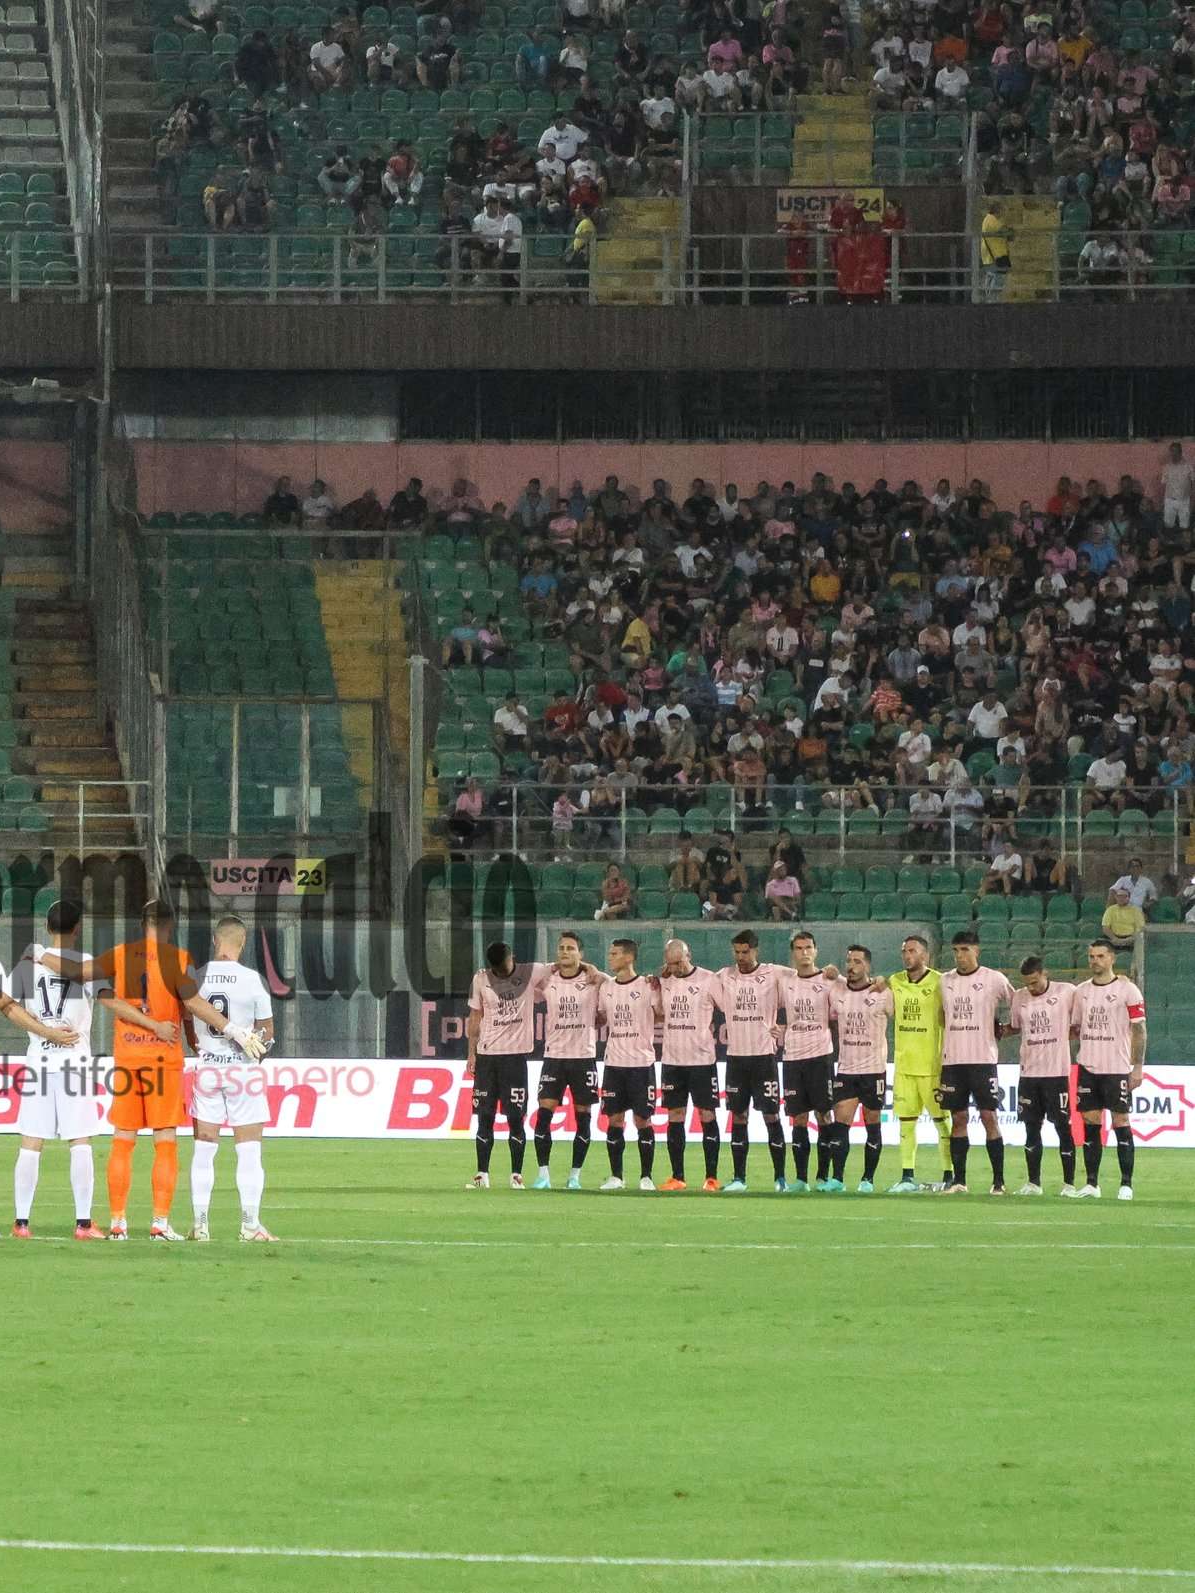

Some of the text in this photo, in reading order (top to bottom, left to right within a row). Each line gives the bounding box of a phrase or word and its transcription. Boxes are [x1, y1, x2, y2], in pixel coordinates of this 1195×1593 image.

[778, 196, 840, 211] USCIT
[212, 867, 323, 886] USCITA 23
[35, 974, 71, 1021] 17
[586, 1071, 598, 1087] 37
[711, 1077, 718, 1092] 5
[876, 1079, 884, 1095] 10
[510, 1087, 525, 1103] 53
[647, 1086, 654, 1101] 6
[763, 1081, 779, 1097] 32
[1059, 1092, 1068, 1108] 17
[1132, 1096, 1172, 1114] DM
